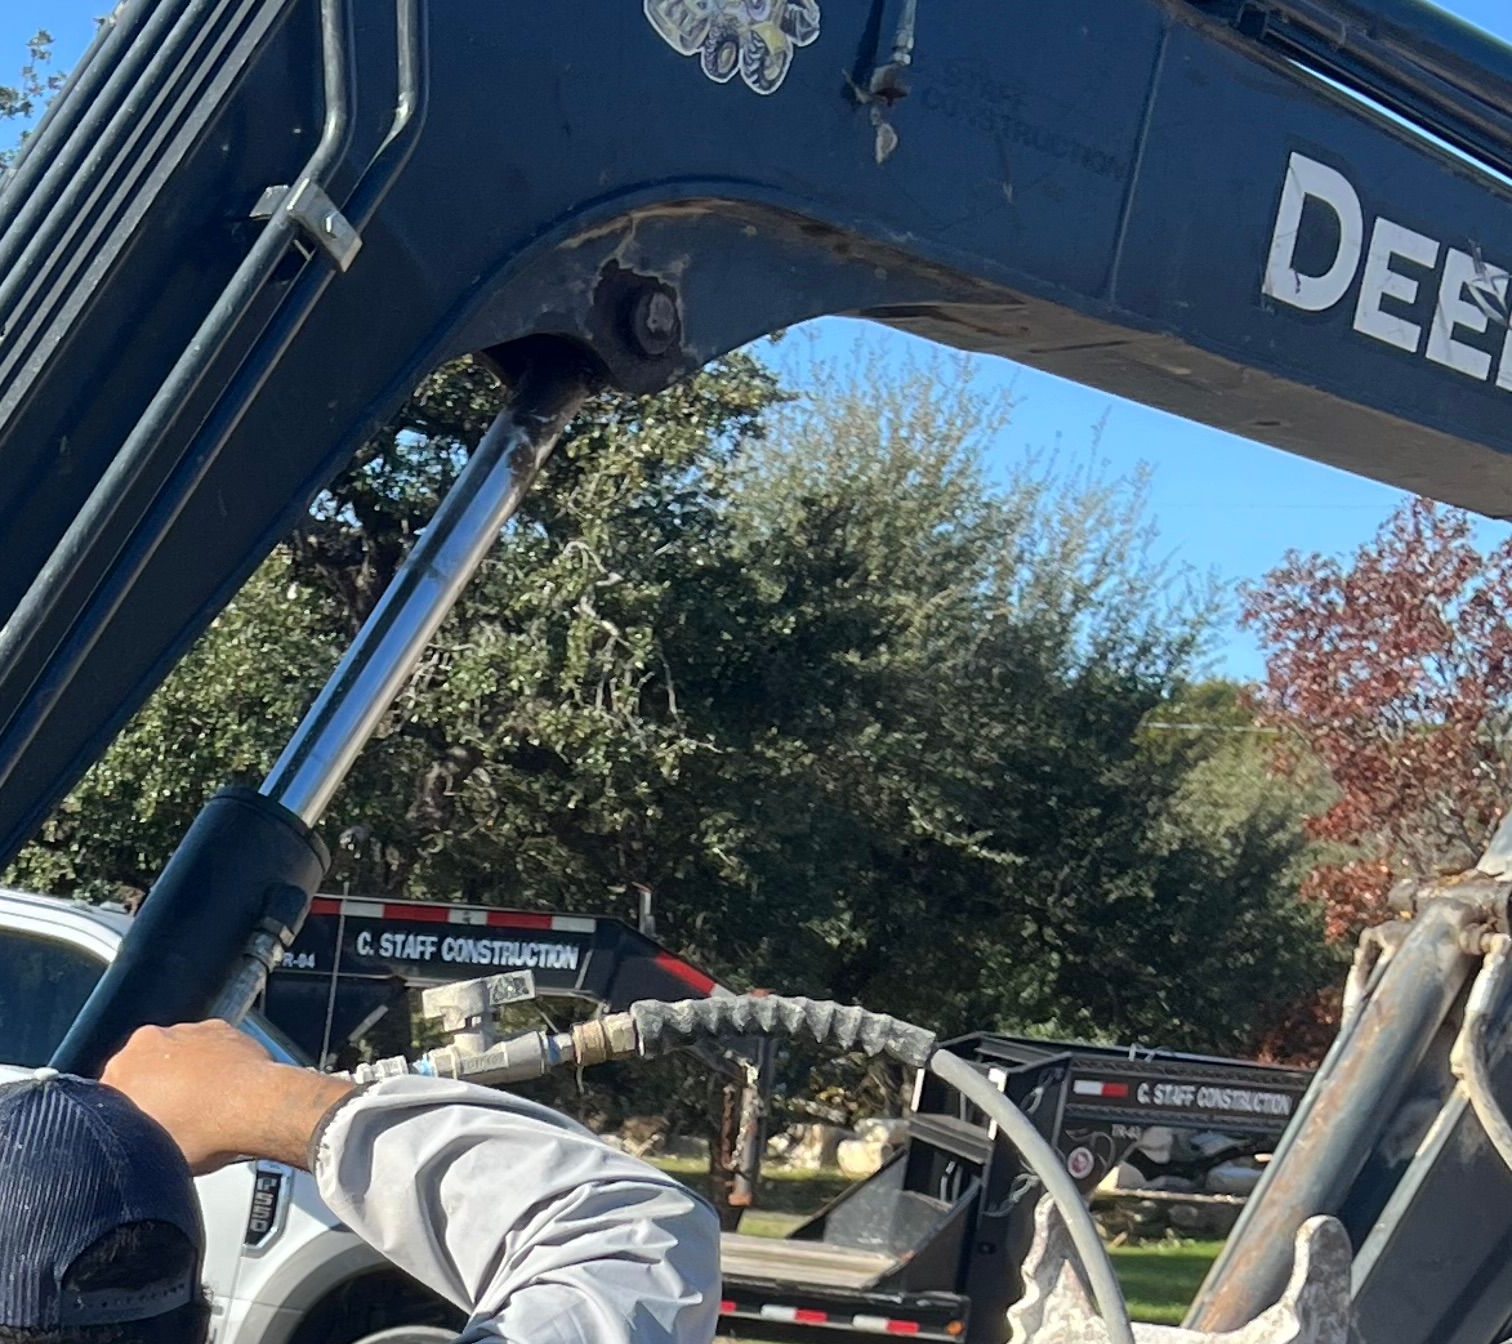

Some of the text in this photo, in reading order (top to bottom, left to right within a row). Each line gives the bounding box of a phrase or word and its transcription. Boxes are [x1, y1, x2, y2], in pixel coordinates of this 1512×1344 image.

[1262, 151, 1512, 392] DEE
[356, 931, 579, 970] C. STAFF CONSTRUCTION
[1137, 1082, 1291, 1115] C. STAFF CONSTRUCTION
